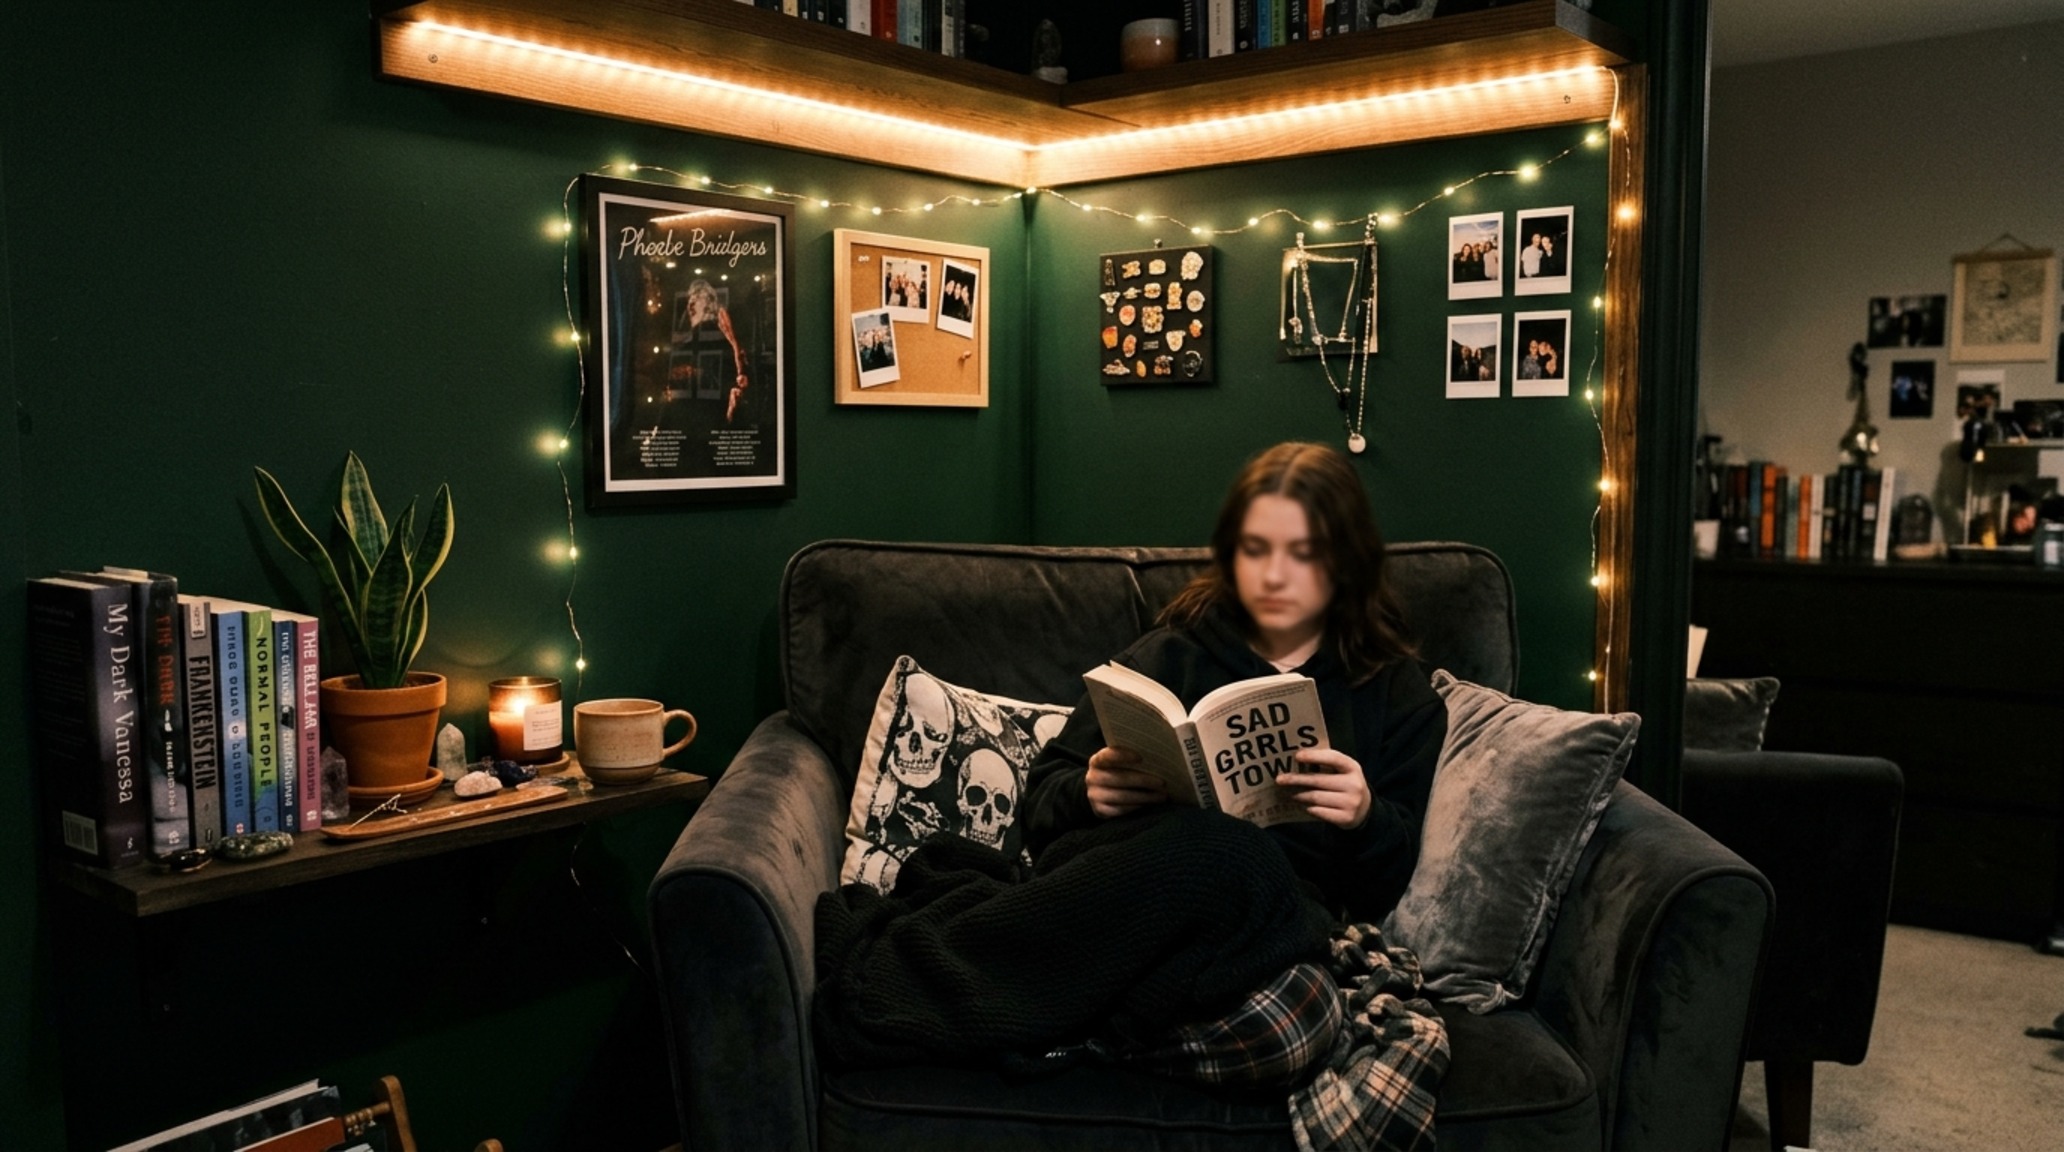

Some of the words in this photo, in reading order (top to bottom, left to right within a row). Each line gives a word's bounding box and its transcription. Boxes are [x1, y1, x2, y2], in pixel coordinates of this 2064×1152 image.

[690, 228, 767, 267] Bridgers
[103, 603, 129, 637] My
[303, 631, 317, 659] THE
[110, 646, 134, 703] Dark
[256, 637, 270, 712] NORMAL
[189, 655, 217, 790] FRANKENSTEIN
[1226, 702, 1291, 739] SAD
[115, 710, 135, 803] Vanessa
[260, 722, 273, 787] PEOPLE
[1215, 725, 1319, 775] GRRLS
